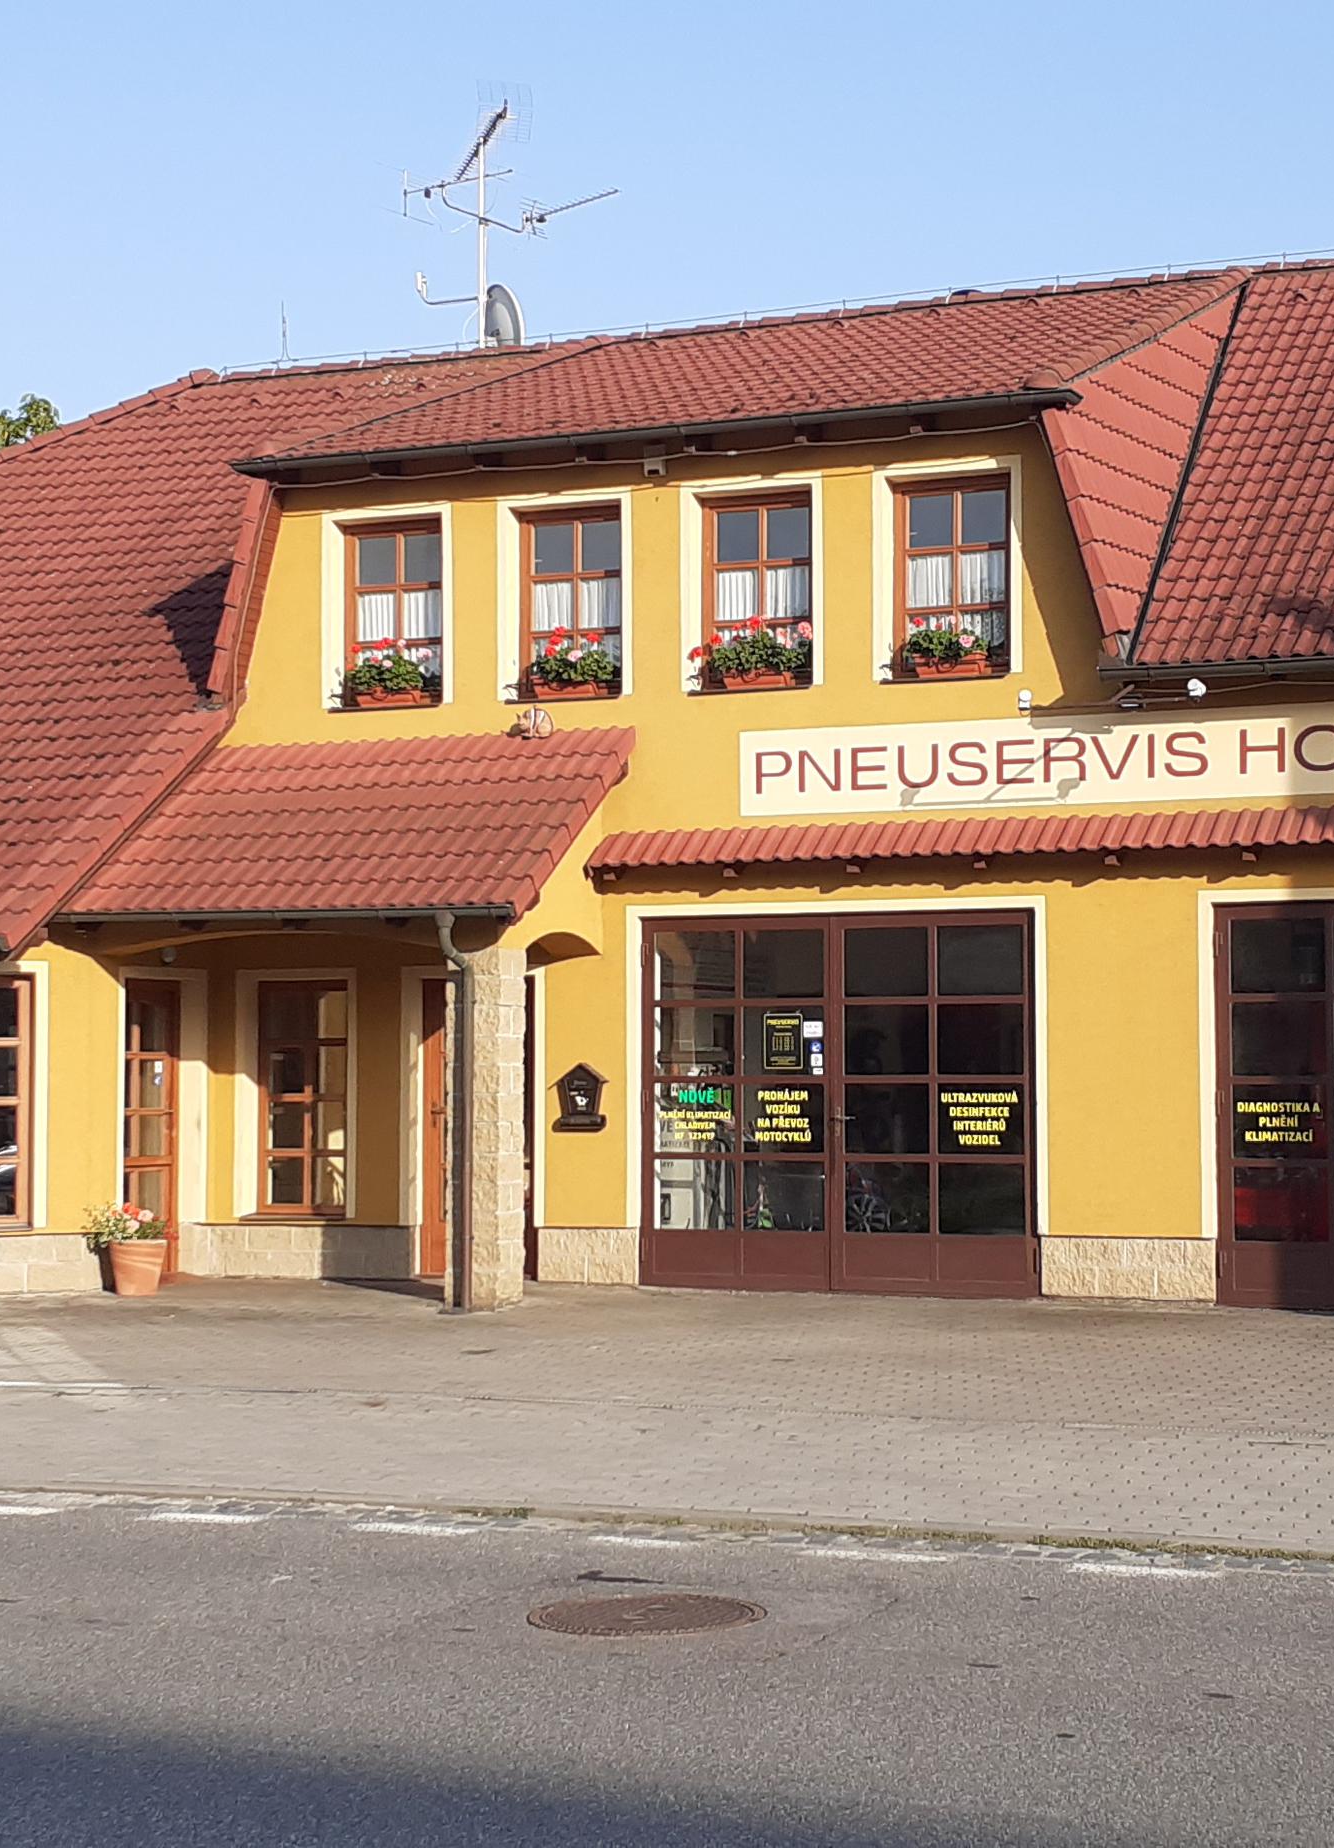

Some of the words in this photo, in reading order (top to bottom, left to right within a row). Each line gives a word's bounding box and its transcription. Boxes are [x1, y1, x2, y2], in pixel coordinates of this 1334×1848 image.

[755, 731, 1208, 795] PNEUSERVIS
[678, 1087, 715, 1104] NOVĚ
[757, 1088, 808, 1101] PRONÁJEM
[941, 1090, 1018, 1103] ULTRAZVUKOVÁ
[766, 1103, 800, 1114] VOZÍKU
[949, 1106, 1010, 1117] DESINFEKCE
[1237, 1102, 1310, 1113] DIAGNOSTIKA
[1312, 1102, 1320, 1112] A
[757, 1118, 771, 1128] NA
[772, 1117, 809, 1128] PŘEVOZ
[953, 1118, 1006, 1131] INTERIÉRŮ
[1258, 1114, 1299, 1127] PLNĚNÍ
[755, 1129, 812, 1142] MOTOCYKLŮ
[958, 1134, 1001, 1145] VOZIDEL
[1244, 1129, 1313, 1142] KLIMATIZACÍ
